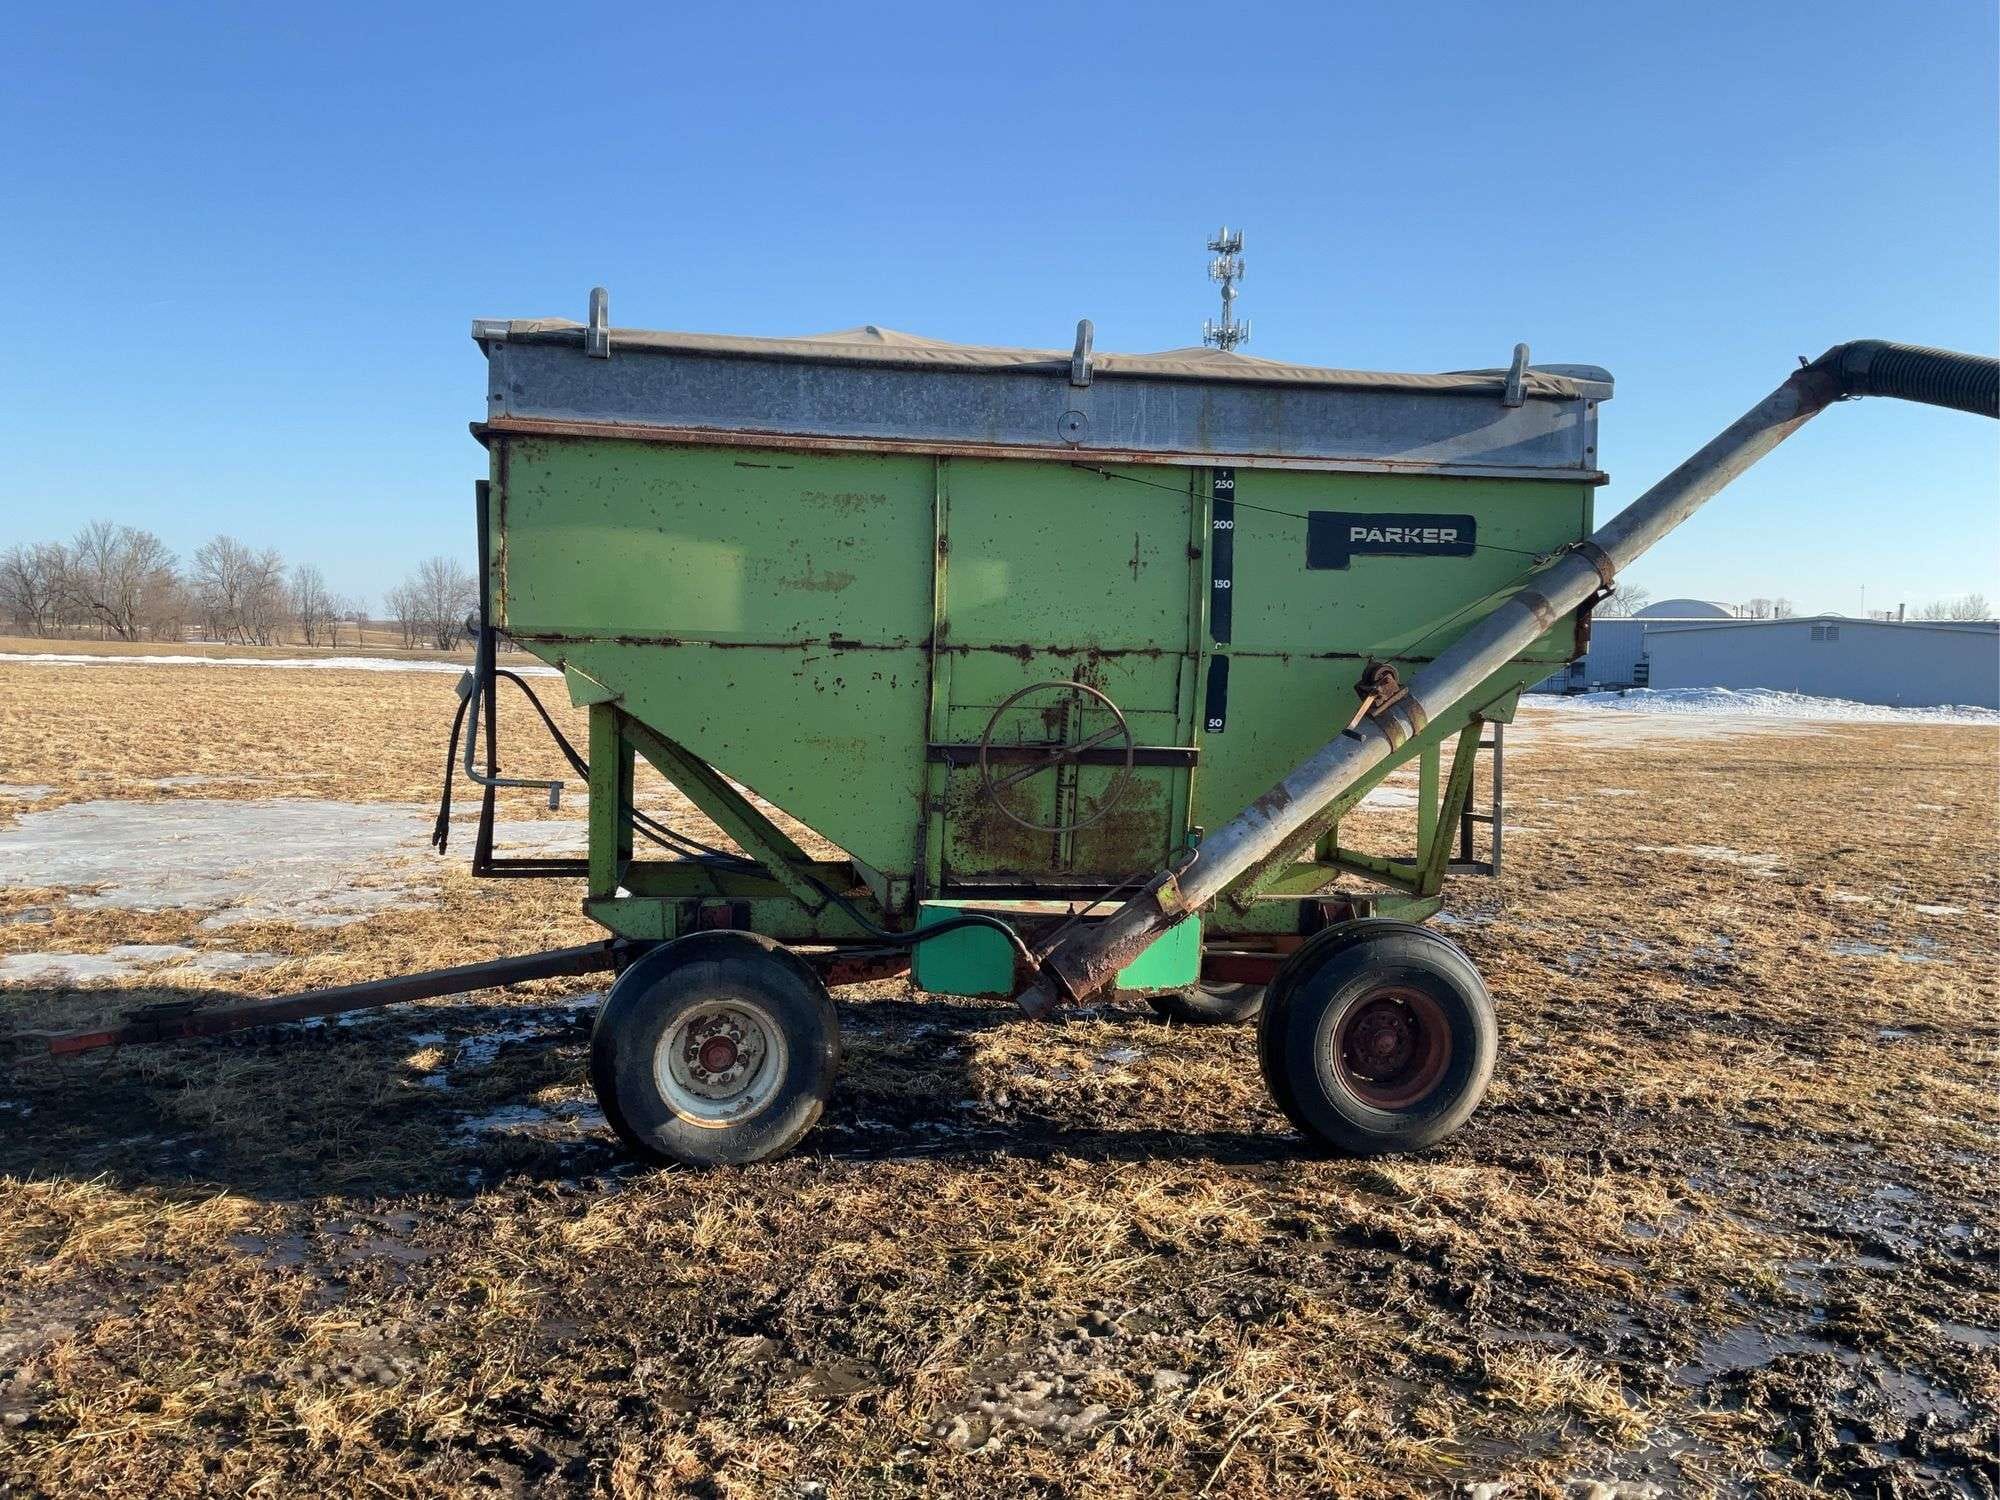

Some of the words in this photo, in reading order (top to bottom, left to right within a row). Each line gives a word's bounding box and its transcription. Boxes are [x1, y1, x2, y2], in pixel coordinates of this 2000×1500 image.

[1214, 479, 1235, 489] 250
[1213, 520, 1234, 530] 200
[1350, 526, 1458, 544] PARKER
[1213, 579, 1231, 589] 150
[1208, 718, 1223, 727] 50
